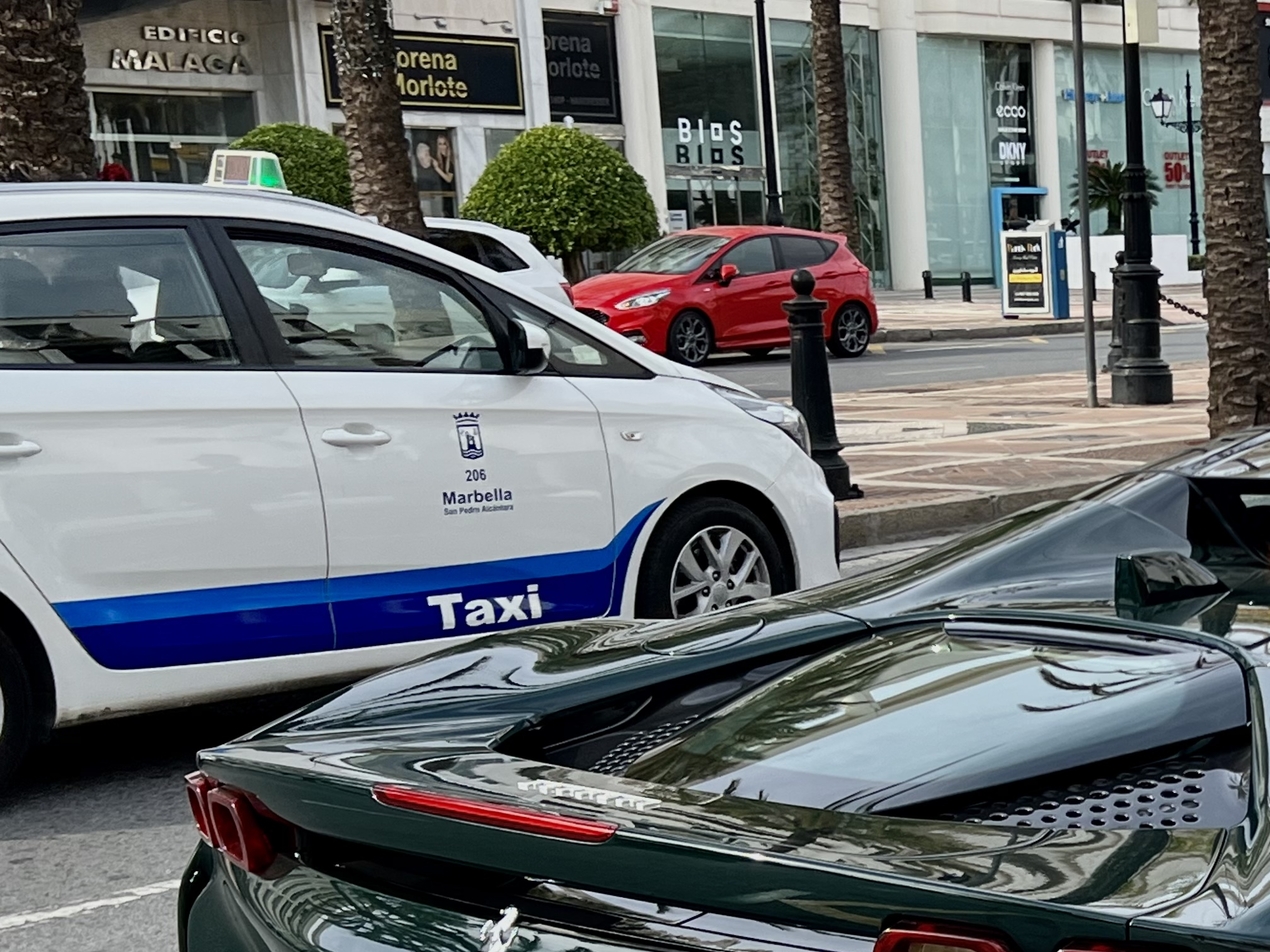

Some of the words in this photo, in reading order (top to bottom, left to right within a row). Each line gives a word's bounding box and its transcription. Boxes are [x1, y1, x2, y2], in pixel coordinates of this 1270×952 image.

[143, 25, 246, 45] EDIFICIO
[544, 35, 592, 54] orena
[111, 48, 253, 75] MALAGA
[396, 50, 458, 71] orena
[548, 57, 601, 79] orlote
[996, 104, 1026, 118] ecco
[999, 141, 1026, 160] DKNY
[1087, 150, 1109, 159] UTLET
[465, 469, 487, 482] 206
[442, 488, 513, 505] Marbella
[426, 583, 543, 631] Taxi
